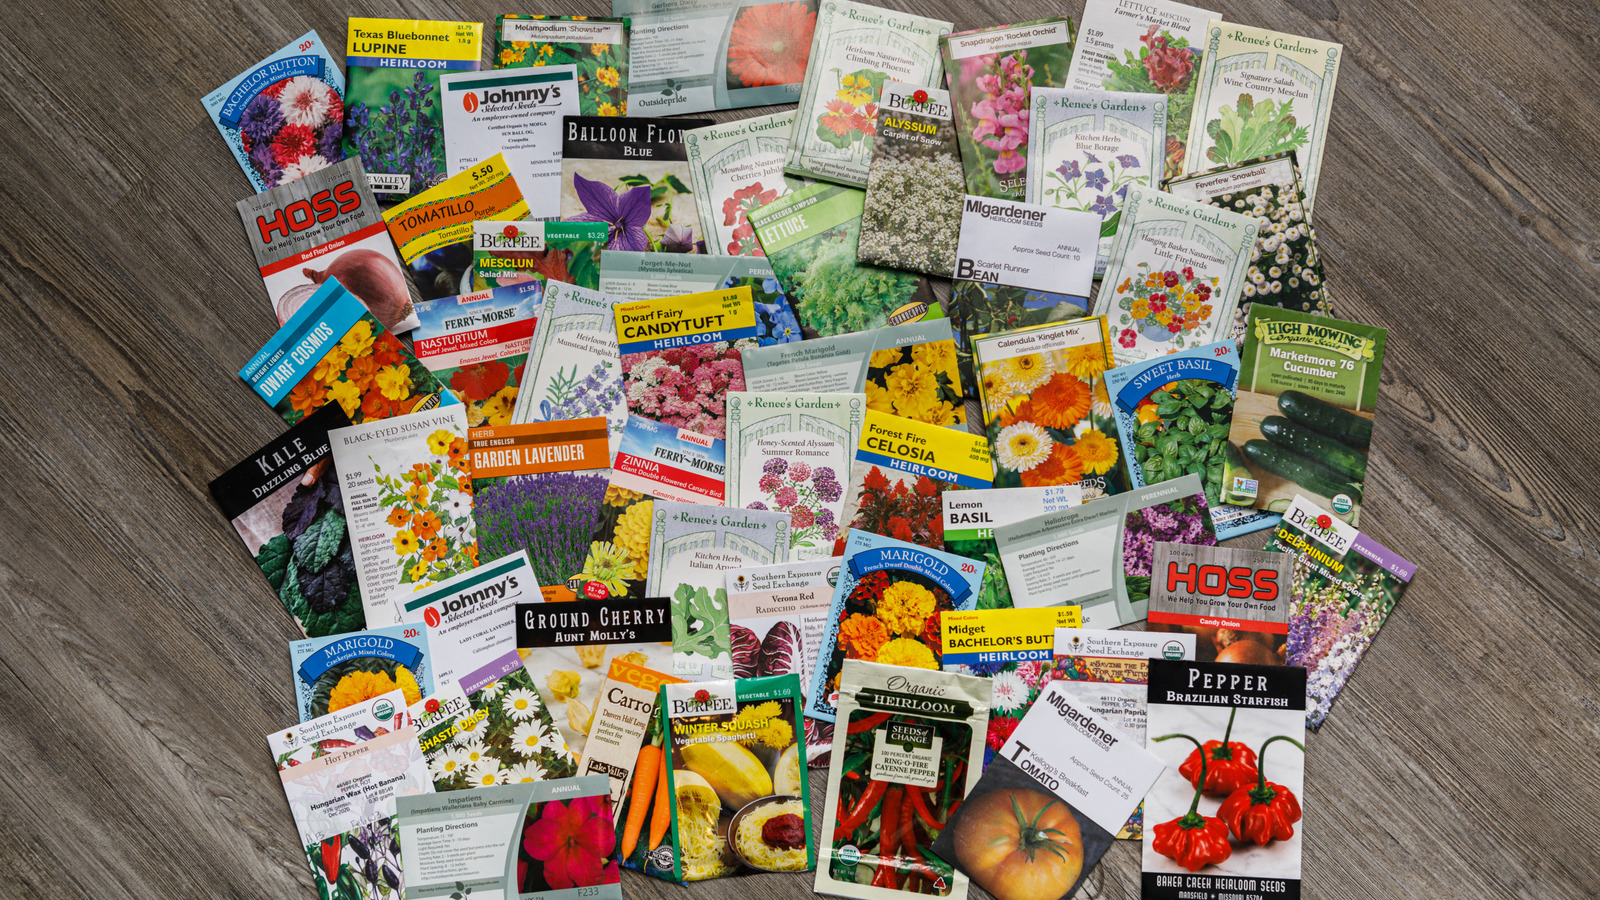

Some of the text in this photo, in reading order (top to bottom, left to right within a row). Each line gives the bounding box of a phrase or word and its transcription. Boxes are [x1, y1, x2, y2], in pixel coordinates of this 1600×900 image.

[1114, 7, 1191, 32] Farmer's Market Blend
[1119, 0, 1191, 23] LETTUCE MESCLUN
[515, 24, 566, 32] Melampodium
[848, 9, 925, 36] Renee's Garden
[354, 29, 450, 42] Texas Bluebonnet
[960, 35, 1002, 48] Snapdragon
[353, 43, 406, 54] LUPINE
[380, 58, 447, 68] HEIRLOOM
[846, 53, 911, 74] Climbing Phoenix
[224, 67, 269, 116] BACHELOR
[269, 56, 316, 73] BUTTON
[480, 85, 561, 105] Johnny's
[1224, 77, 1309, 99] Wine Country Mesclun
[639, 96, 687, 107] Outsidepride
[1061, 98, 1140, 112] Renee's Garden
[568, 122, 638, 142] BALLOON
[884, 117, 937, 135] ALYSSUM
[883, 129, 908, 141] Carpet
[920, 135, 942, 146] Snow
[624, 146, 652, 157] BLUE
[1076, 142, 1119, 153] Blue Borage
[472, 165, 493, 180] $.50
[1195, 177, 1228, 189] Feverfew
[256, 180, 361, 244] HOSS
[399, 201, 495, 232] TOMATILLO Purple
[588, 231, 605, 239] $3.29
[759, 214, 809, 247] LETTUCE
[301, 240, 345, 261] Red Floyd Onion
[1013, 245, 1034, 255] Approx
[1035, 249, 1050, 258] Seed
[1051, 251, 1071, 260] Count:
[479, 258, 533, 268] MESCLUN
[958, 259, 999, 282] BEAN
[977, 260, 1030, 274] Scarlet Runner
[479, 271, 499, 279] Salad
[461, 292, 489, 304] ANNUAL
[622, 308, 683, 324] Dwarf Fairy
[624, 315, 724, 339] CANDYTUFT
[1268, 323, 1362, 349] HIGH MOWING
[421, 330, 488, 349] NASTURTIUM
[654, 332, 722, 349] HEIRLOOM
[896, 335, 926, 345] ANNUAL
[997, 336, 1035, 348] Calendula
[259, 321, 334, 398] DWARF COSMOS
[1270, 347, 1355, 371] Marketmore 76
[1134, 360, 1213, 390] SWEET BASIL
[1283, 361, 1338, 380] Cucumber
[755, 397, 834, 409] Renee's Garden
[343, 414, 455, 445] BLACK-EYED SUSAN VINE
[869, 424, 927, 445] Forest Fire
[490, 438, 515, 446] ENGLISH
[867, 437, 935, 463] CELOSIA
[256, 437, 307, 477] KALE
[474, 444, 585, 469] GARDEN LAVENDER
[795, 449, 829, 457] Romance
[252, 443, 330, 499] DAZZLING BLUE
[623, 455, 660, 473] ZINNIA
[890, 458, 958, 482] HEIRLOOM
[345, 471, 362, 480] $1.99
[621, 464, 722, 497] Giant Double Flowered Canary Bird
[949, 501, 983, 509] Lemon
[950, 512, 993, 524] BASIL
[1018, 539, 1079, 561] Planting Directions
[1278, 527, 1344, 574] DELPHINIUM
[881, 550, 949, 576] MARIGOLD
[1272, 540, 1366, 600] Pacific Giant Mixed Colors
[1167, 561, 1279, 601] HOSS
[440, 575, 519, 618] Johnny's
[1179, 597, 1194, 605] Help
[1195, 597, 1207, 605] You
[1209, 599, 1226, 608] Grow
[1227, 601, 1242, 609] Your
[1243, 602, 1258, 610] Own
[1259, 604, 1276, 612] Food
[525, 607, 665, 630] GROUND CHERRY
[756, 605, 796, 614] RADICCHIO
[948, 625, 985, 636] Midget
[1200, 618, 1240, 628] Candy Onion
[555, 629, 636, 642] AUNT MOLLY'S
[949, 637, 1023, 648] BACHELOR'S
[325, 637, 394, 659] MARIGOLD
[979, 650, 1049, 662] HEIRLOOM
[887, 675, 946, 697] Organic
[1189, 668, 1268, 692] PEPPER
[673, 699, 733, 715] BURPEE
[873, 694, 956, 714] HEIRLOOM
[1167, 691, 1289, 707] BRAZILIAN STARFISH
[419, 706, 491, 753] SHASTA DAISY
[674, 719, 769, 735] WINTER SQUASH
[892, 725, 921, 735] SEEDS
[675, 732, 756, 745] Vegetable Spaghetti
[589, 760, 628, 780] Lake Valley
[875, 764, 936, 778] CAYENNE PEPPER
[884, 757, 928, 769] RING-O-FIRE
[448, 794, 482, 804] Impatiens
[1157, 875, 1286, 893] BAKER CREEK HEIRLOOM SEEDS
